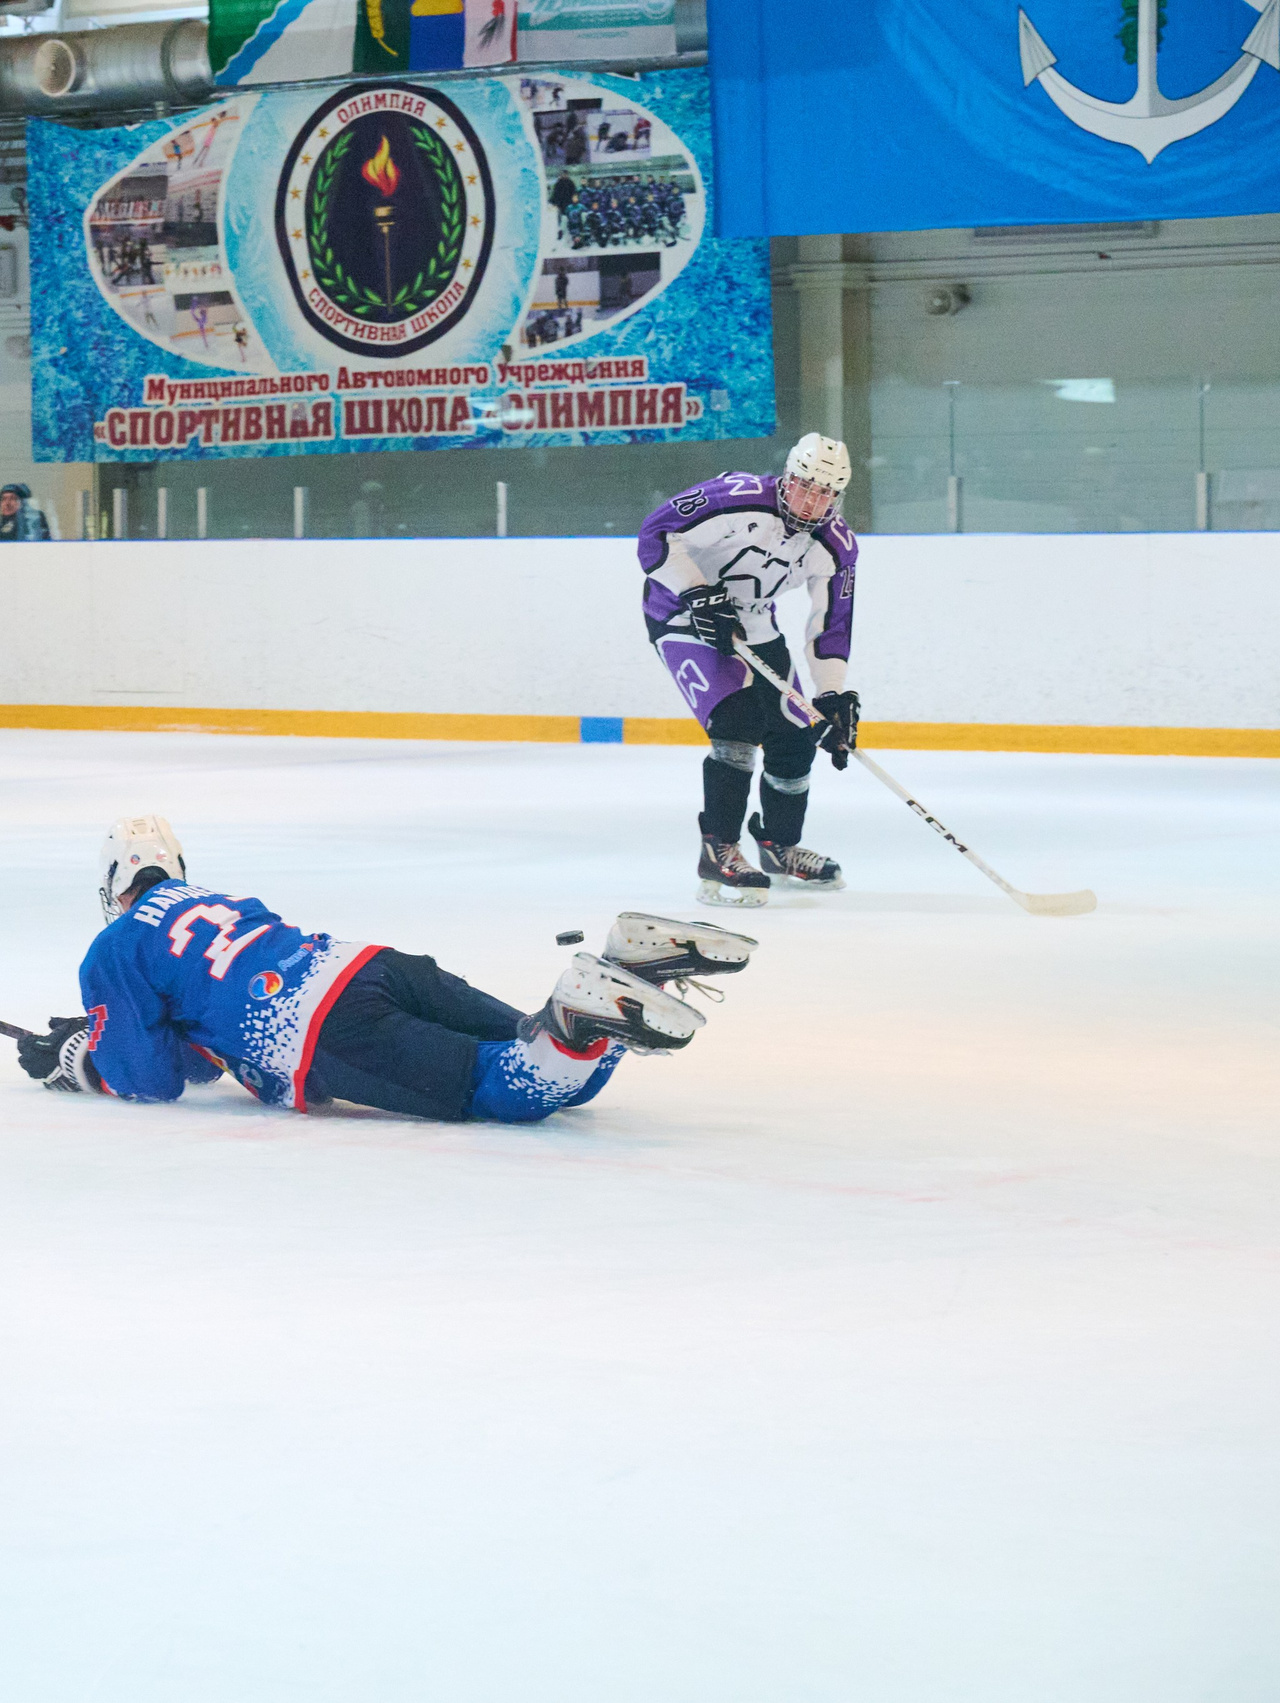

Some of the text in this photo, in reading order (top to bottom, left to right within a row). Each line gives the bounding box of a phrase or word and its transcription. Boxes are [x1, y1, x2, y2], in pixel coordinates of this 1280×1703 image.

[337, 92, 427, 124] ОЛИМПИЯ
[308, 281, 467, 342] СПОРТИВНАЯ ШКОЛА
[147, 373, 329, 405] Муниципального
[337, 366, 488, 390] Автономного
[344, 396, 472, 436] ШКОЛА
[692, 592, 731, 609] CC
[906, 799, 968, 853] CCM
